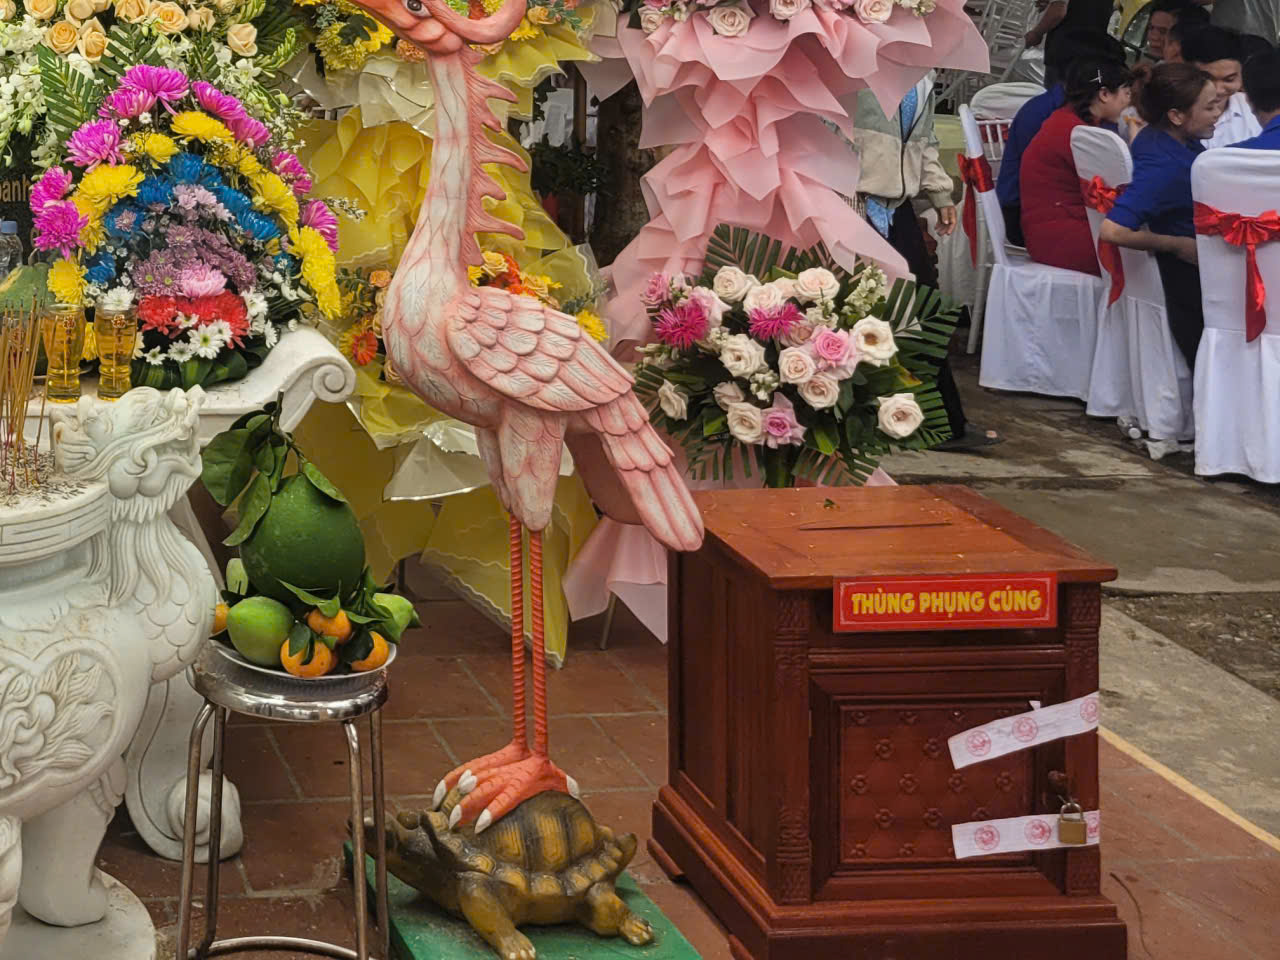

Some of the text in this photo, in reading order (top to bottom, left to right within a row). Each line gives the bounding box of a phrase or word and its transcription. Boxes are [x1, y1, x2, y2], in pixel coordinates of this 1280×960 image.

[851, 585, 1041, 618] THÙNG PHỤNG CÚNG
